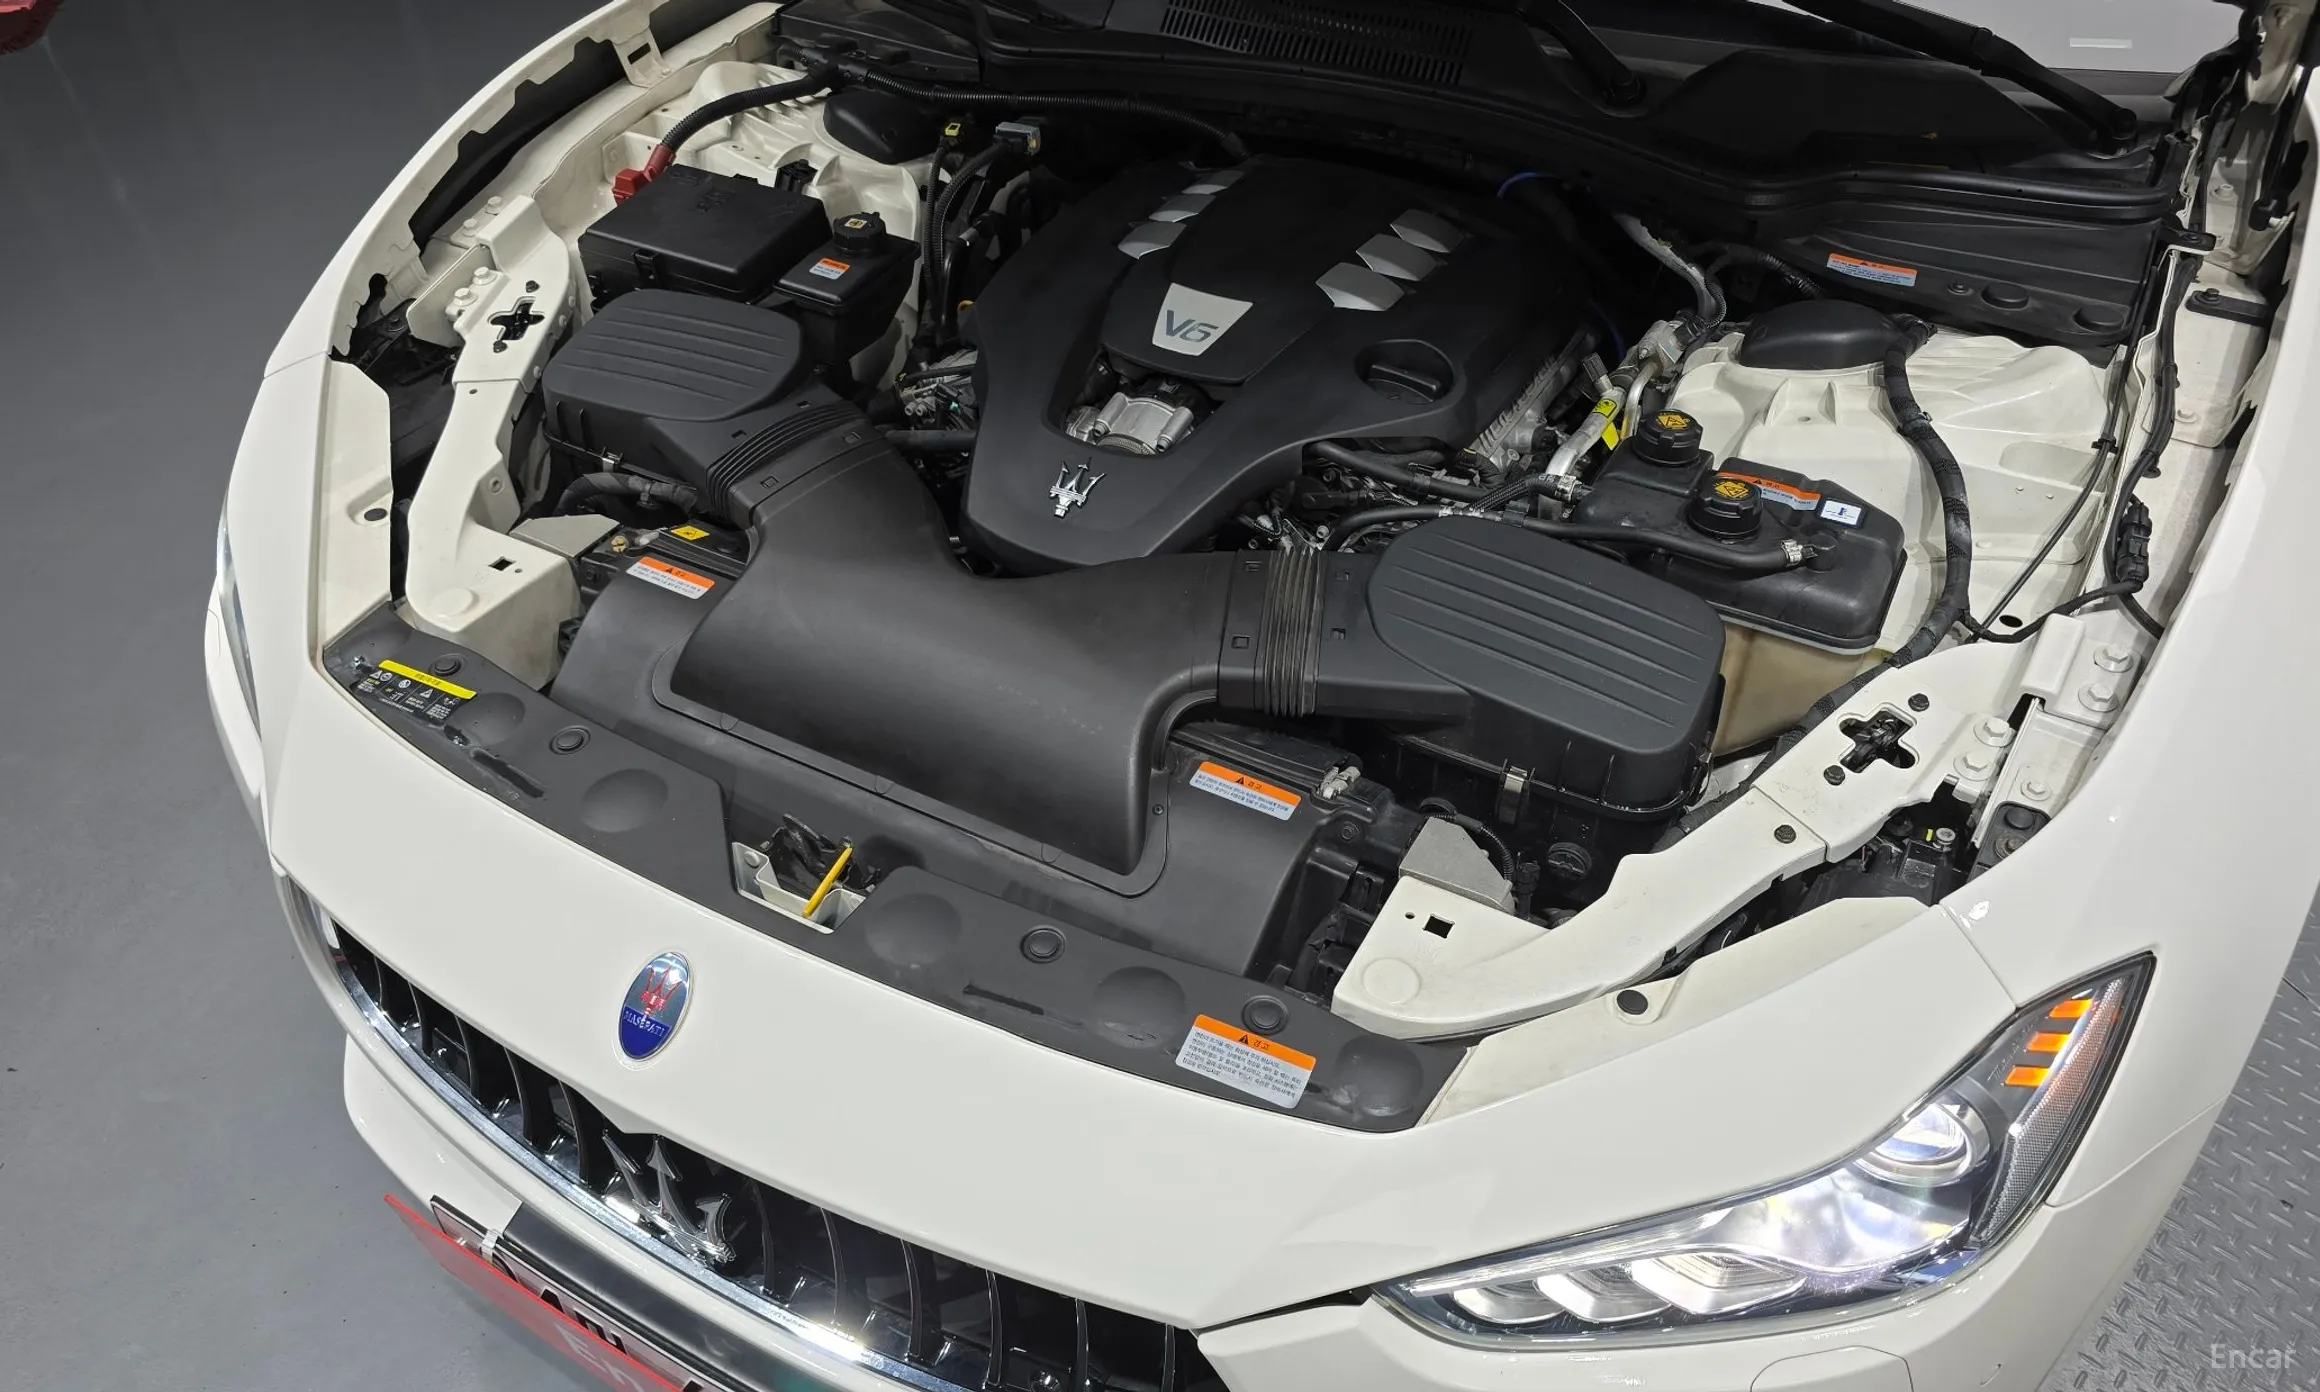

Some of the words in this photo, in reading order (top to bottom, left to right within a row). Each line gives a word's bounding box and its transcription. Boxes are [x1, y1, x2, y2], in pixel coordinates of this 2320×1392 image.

[1166, 309, 1219, 343] V6
[624, 1011, 665, 1036] MASERATI
[1253, 1039, 1271, 1051] 경고
